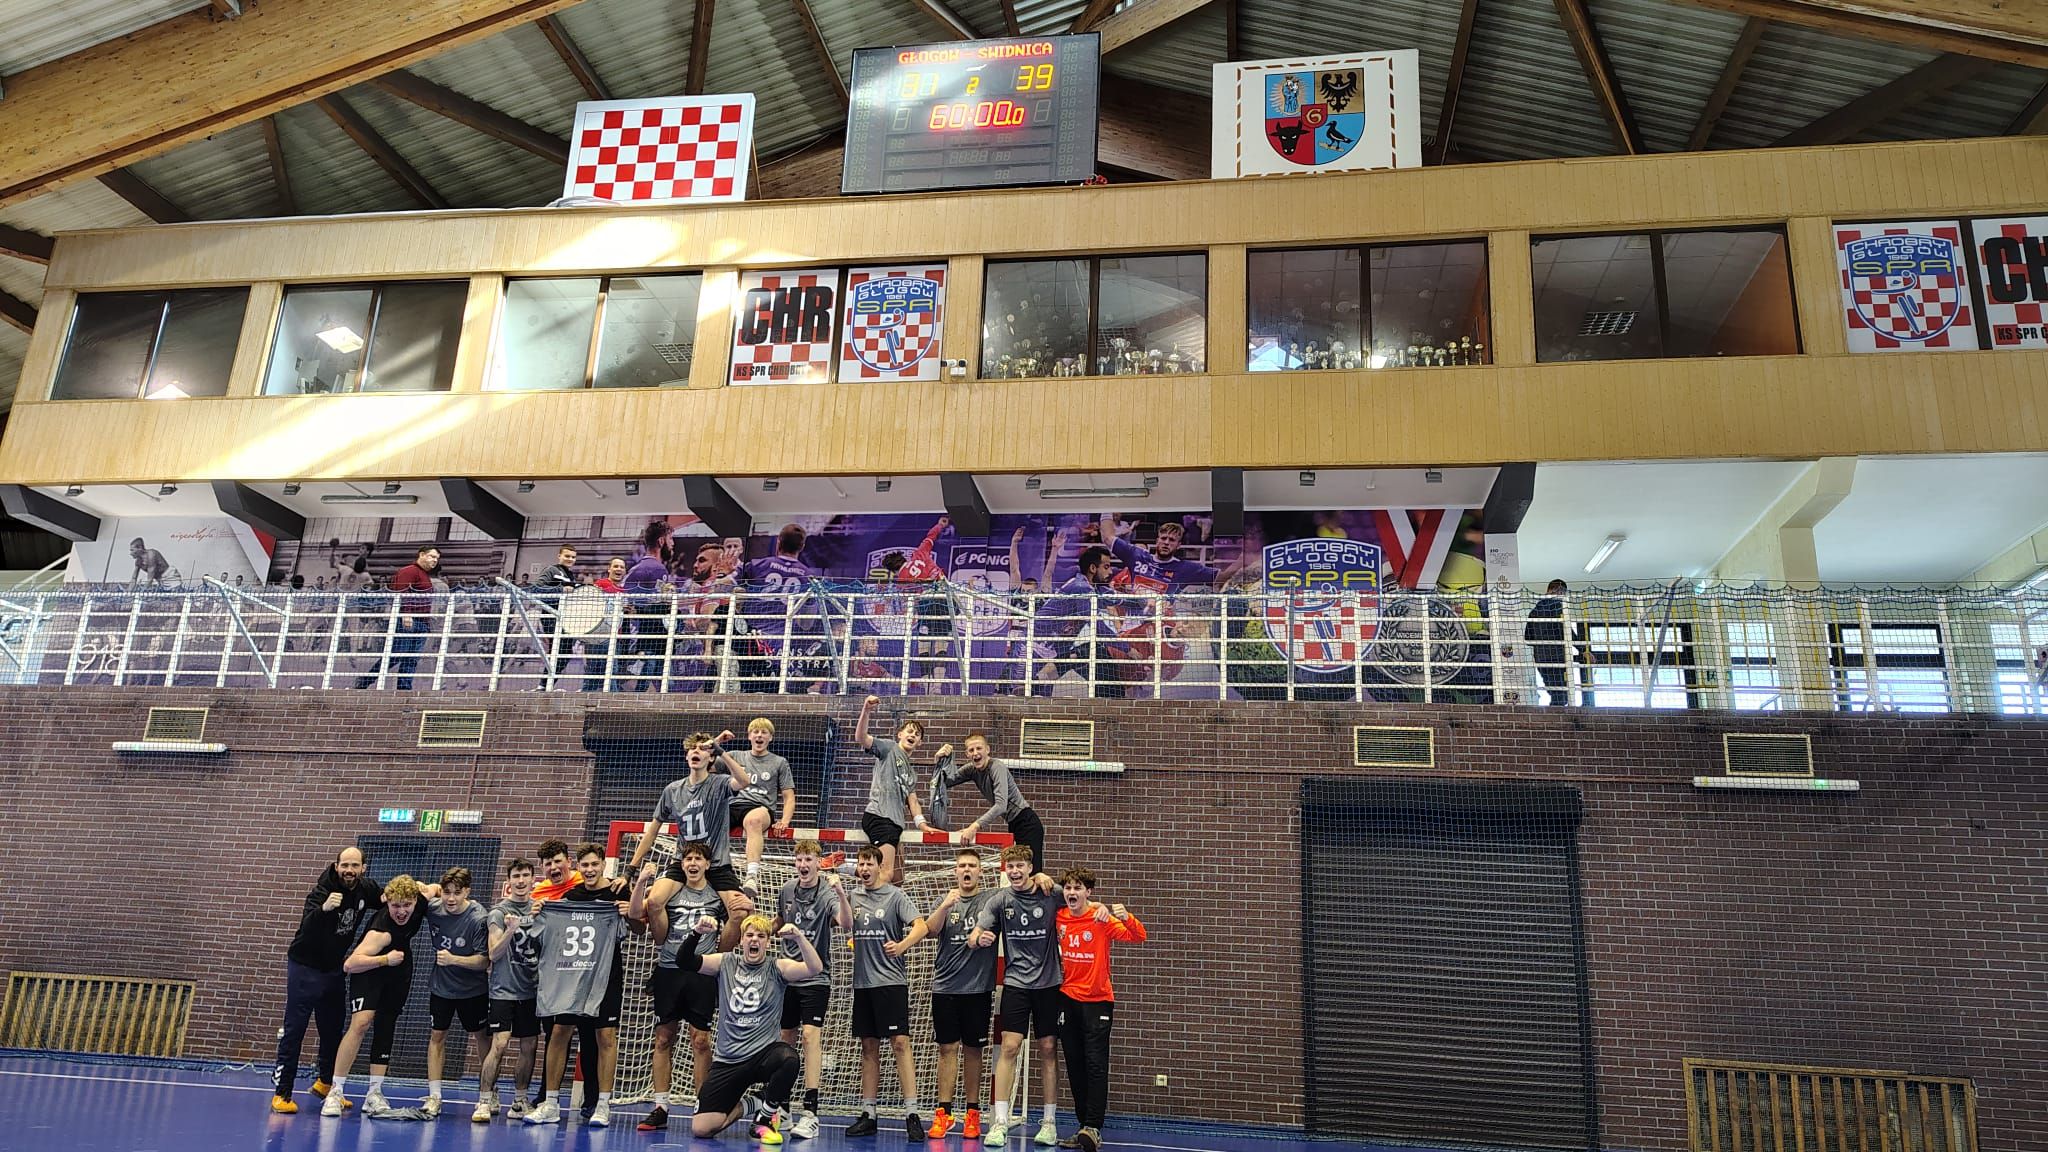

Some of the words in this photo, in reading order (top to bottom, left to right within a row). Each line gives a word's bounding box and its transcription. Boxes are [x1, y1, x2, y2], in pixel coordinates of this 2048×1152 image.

[1016, 64, 1054, 91] 39
[966, 76, 980, 94] 2
[741, 286, 834, 344] CHR
[1998, 328, 2012, 340] KS
[2016, 327, 2038, 340] SPR
[736, 366, 747, 376] KS
[750, 366, 766, 376] SPR
[968, 553, 1010, 566] PGNiG
[1133, 561, 1149, 574] 28
[682, 812, 708, 841] 11
[795, 911, 802, 925] 8
[863, 913, 870, 925] 5
[963, 916, 976, 930] 19
[1020, 912, 1029, 926] 6
[440, 935, 452, 950] 23
[563, 925, 596, 957] 33
[1068, 934, 1080, 948] 14
[1063, 951, 1095, 959] JUAN
[351, 997, 364, 1013] 17
[730, 986, 760, 1013] 69
